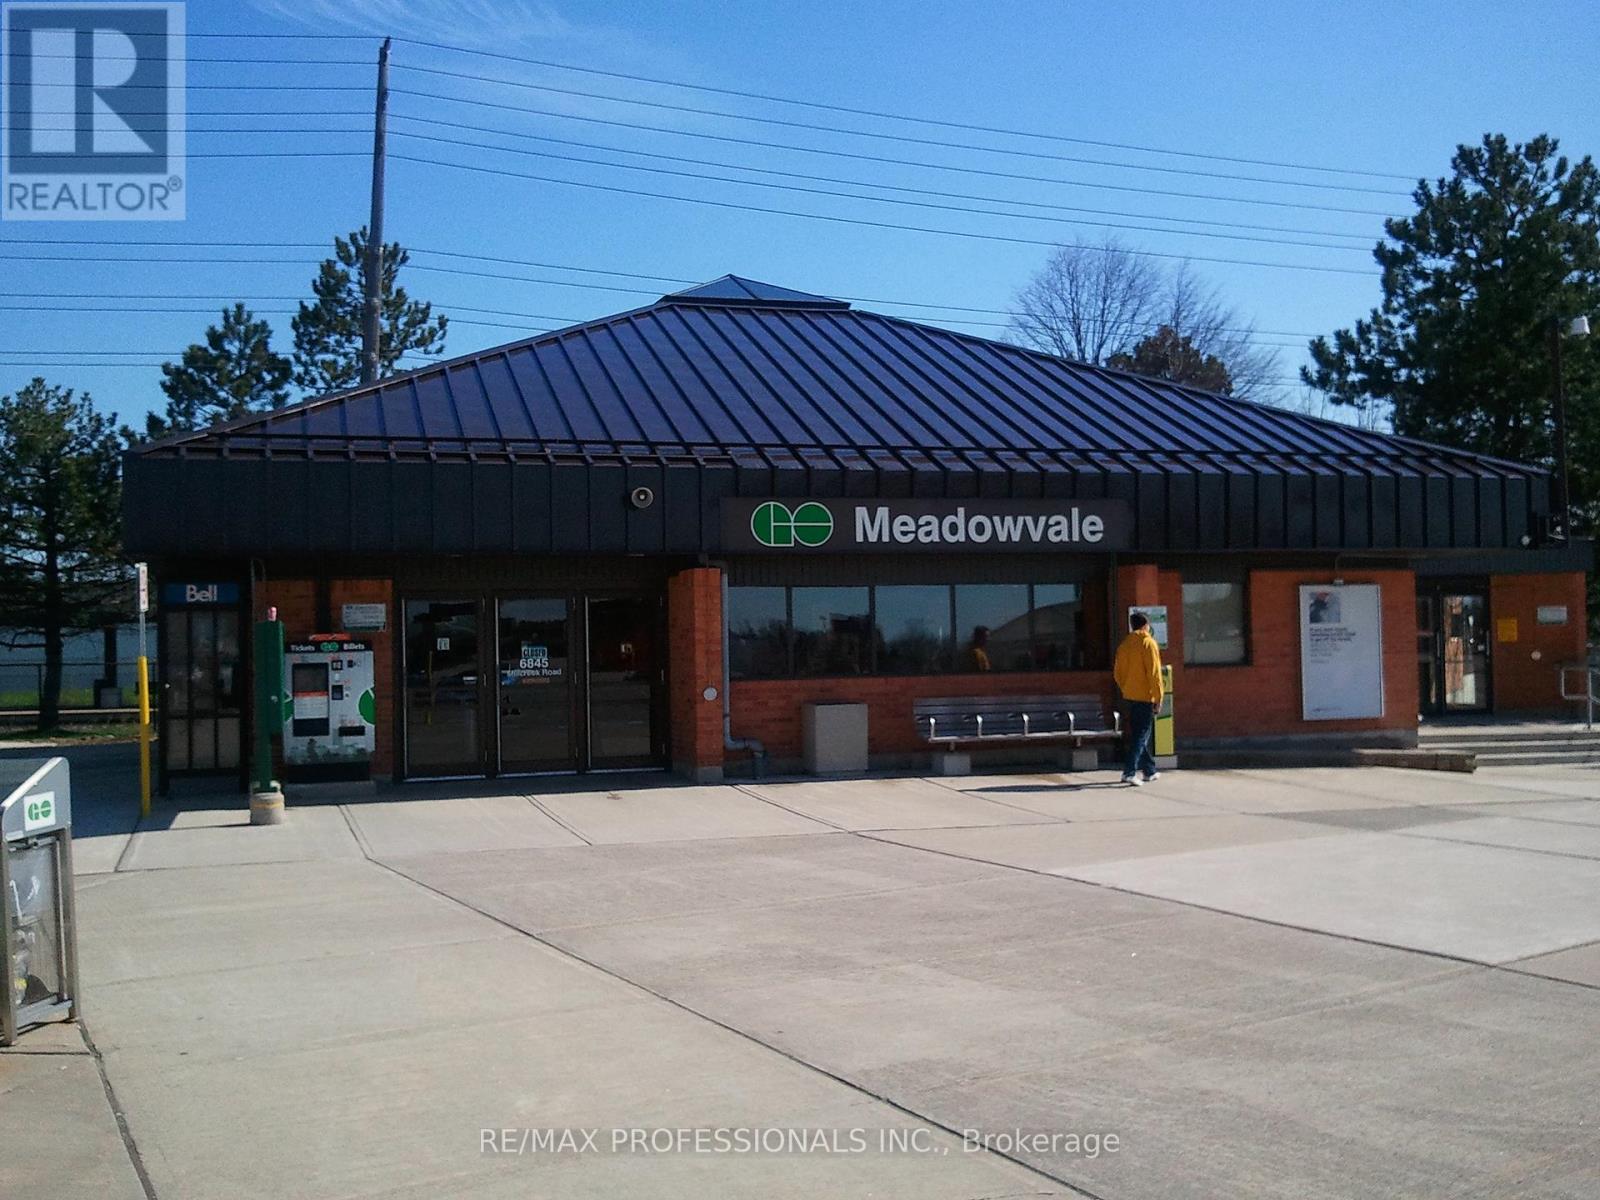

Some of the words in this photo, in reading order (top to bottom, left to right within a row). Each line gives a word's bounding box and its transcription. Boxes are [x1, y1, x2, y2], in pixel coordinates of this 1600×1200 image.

[854, 506, 1104, 544] Meadowvale
[185, 584, 218, 602] Bell
[519, 658, 548, 669] 6845
[542, 669, 562, 677] Road
[28, 800, 52, 821] GO
